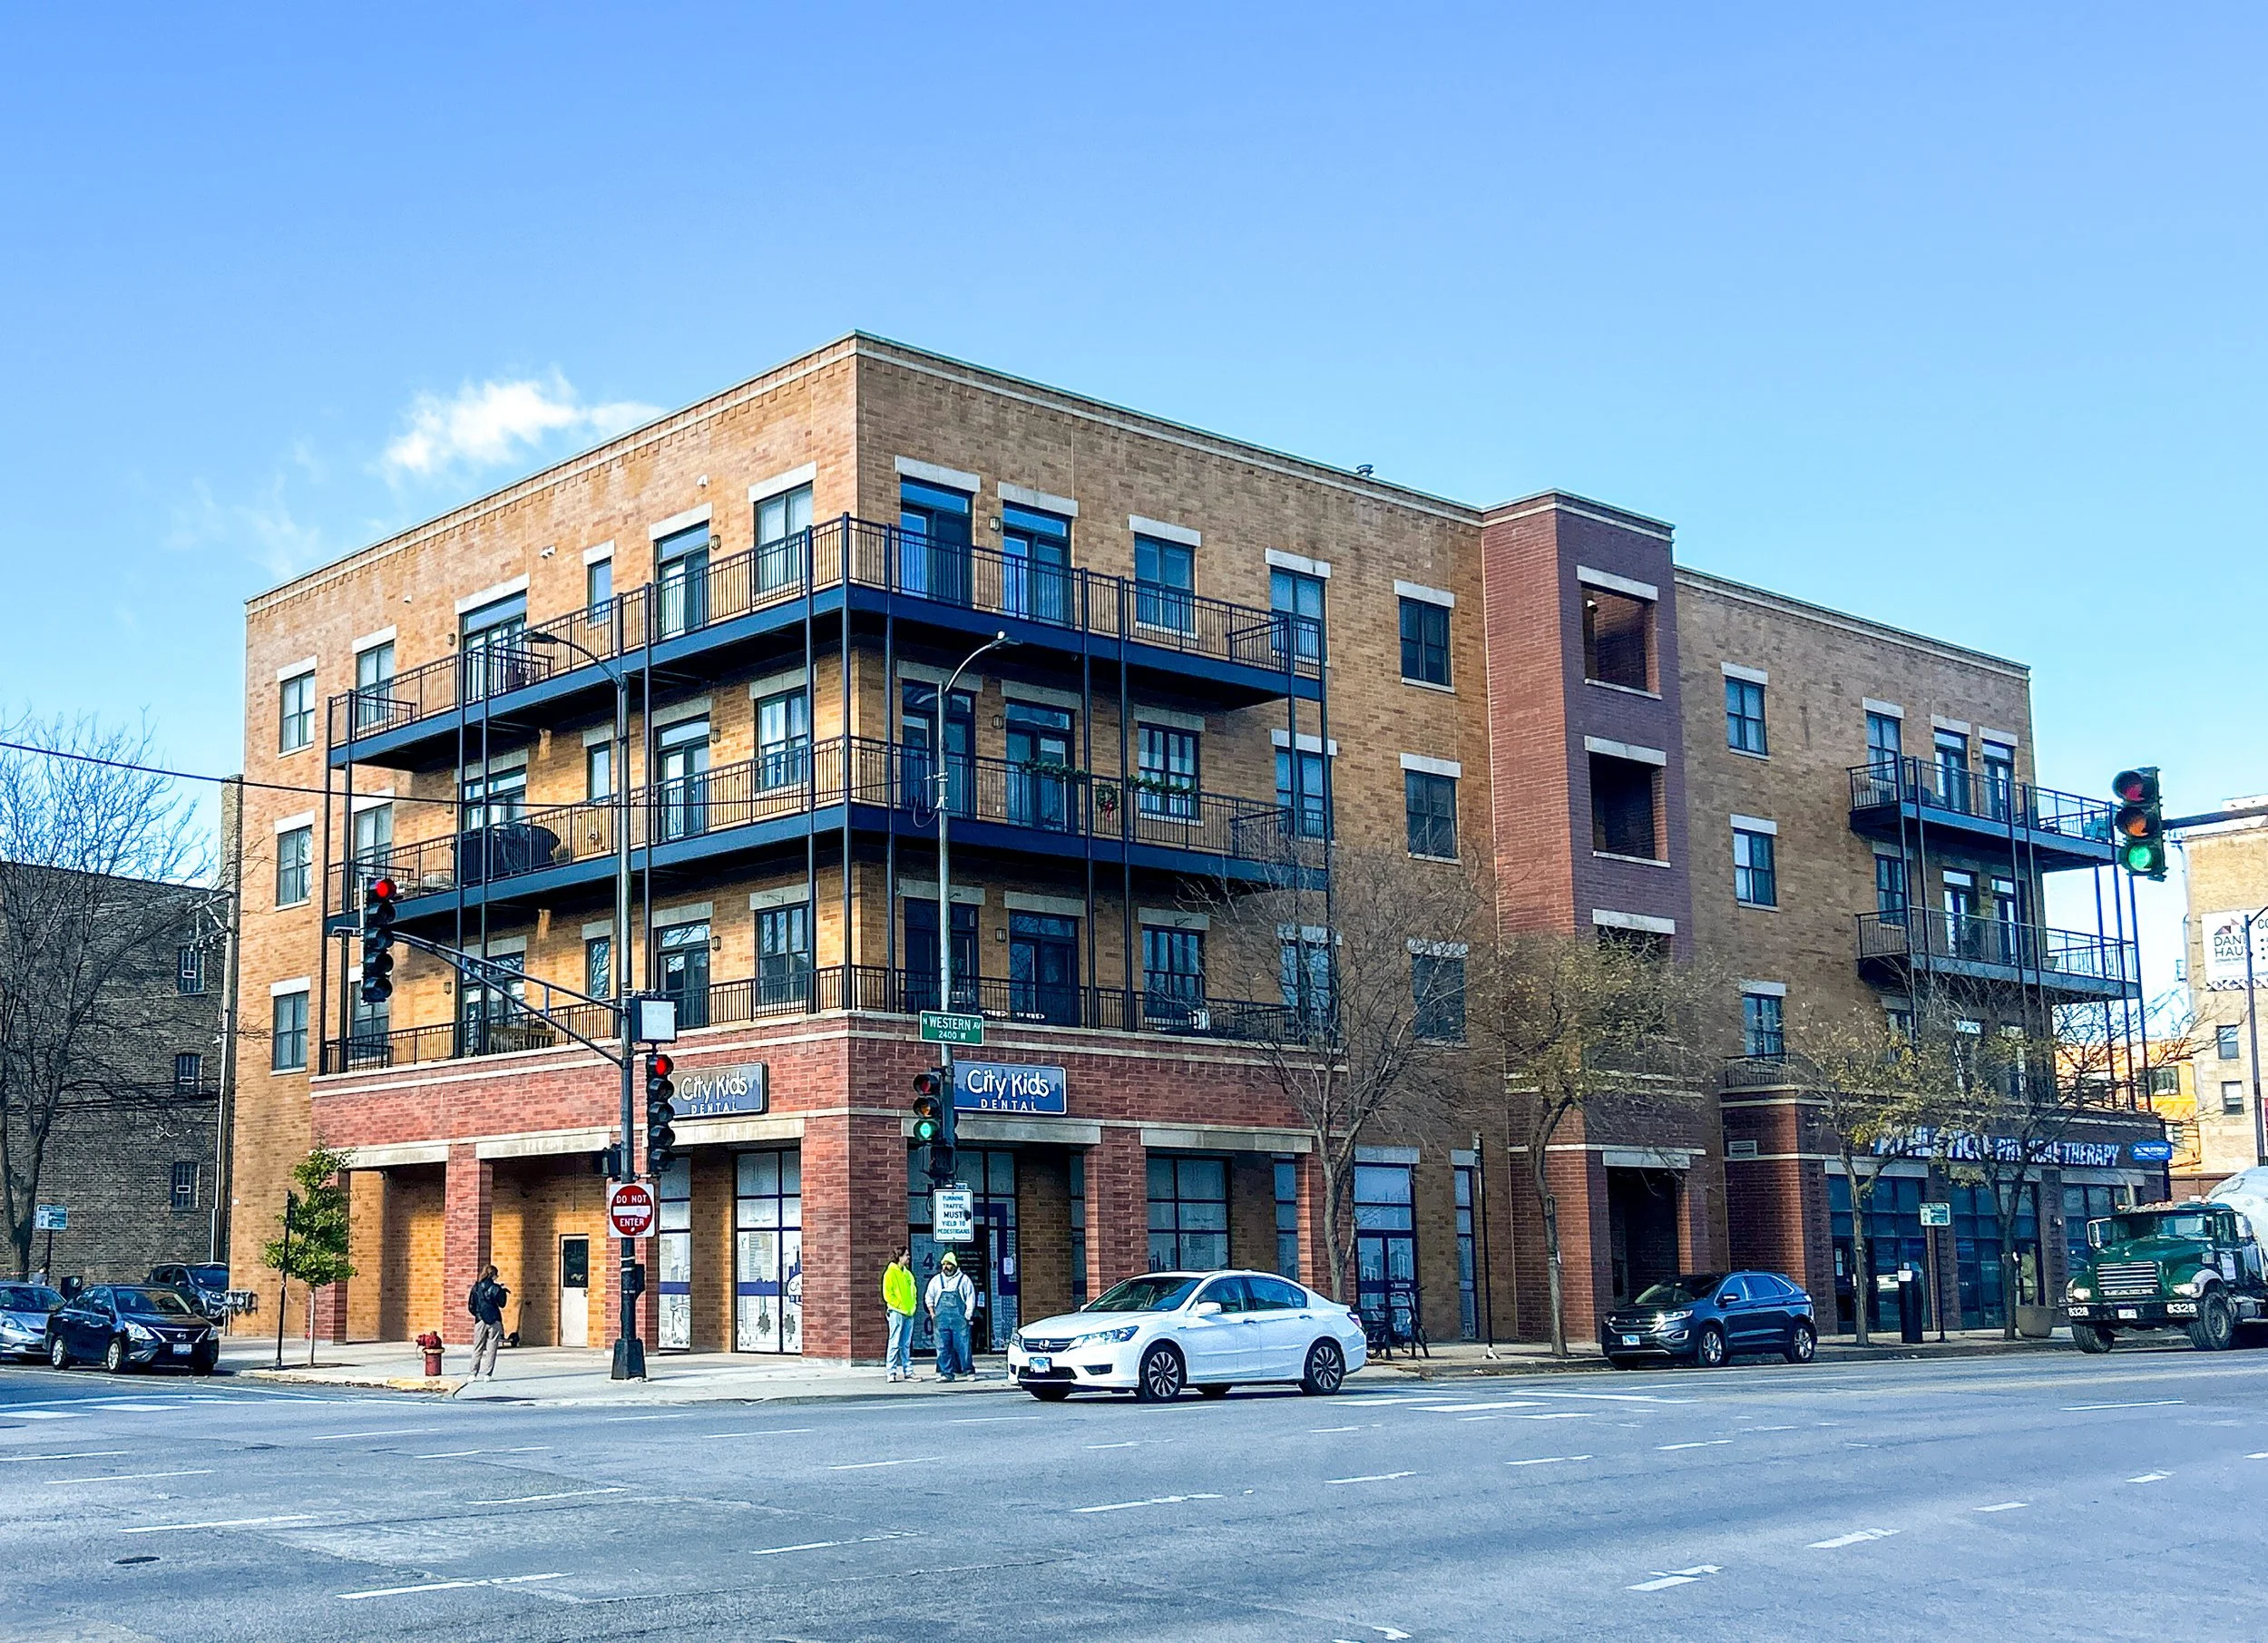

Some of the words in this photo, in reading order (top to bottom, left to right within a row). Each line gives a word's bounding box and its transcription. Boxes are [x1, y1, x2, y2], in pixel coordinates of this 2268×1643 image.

[2214, 935, 2245, 946] DAN
[2214, 946, 2245, 957] HAU
[929, 1015, 971, 1031] WESTERN
[973, 1022, 982, 1030] AV
[938, 1030, 957, 1040] 2400
[960, 1032, 966, 1041] W
[680, 1074, 714, 1103] City
[716, 1071, 748, 1100] Kids
[967, 1068, 1007, 1100] City
[1011, 1071, 1050, 1098] Kids
[691, 1100, 738, 1115] DENTAL
[981, 1098, 1037, 1111] DENTAL
[1996, 1137, 2062, 1164] PHYICAL
[2063, 1142, 2120, 1167] THERAPY
[616, 1195, 628, 1204] DO
[631, 1194, 647, 1204] NOT
[620, 1218, 645, 1227] ENTER
[2068, 1306, 2088, 1317] 8328
[2166, 1303, 2197, 1315] 8328
